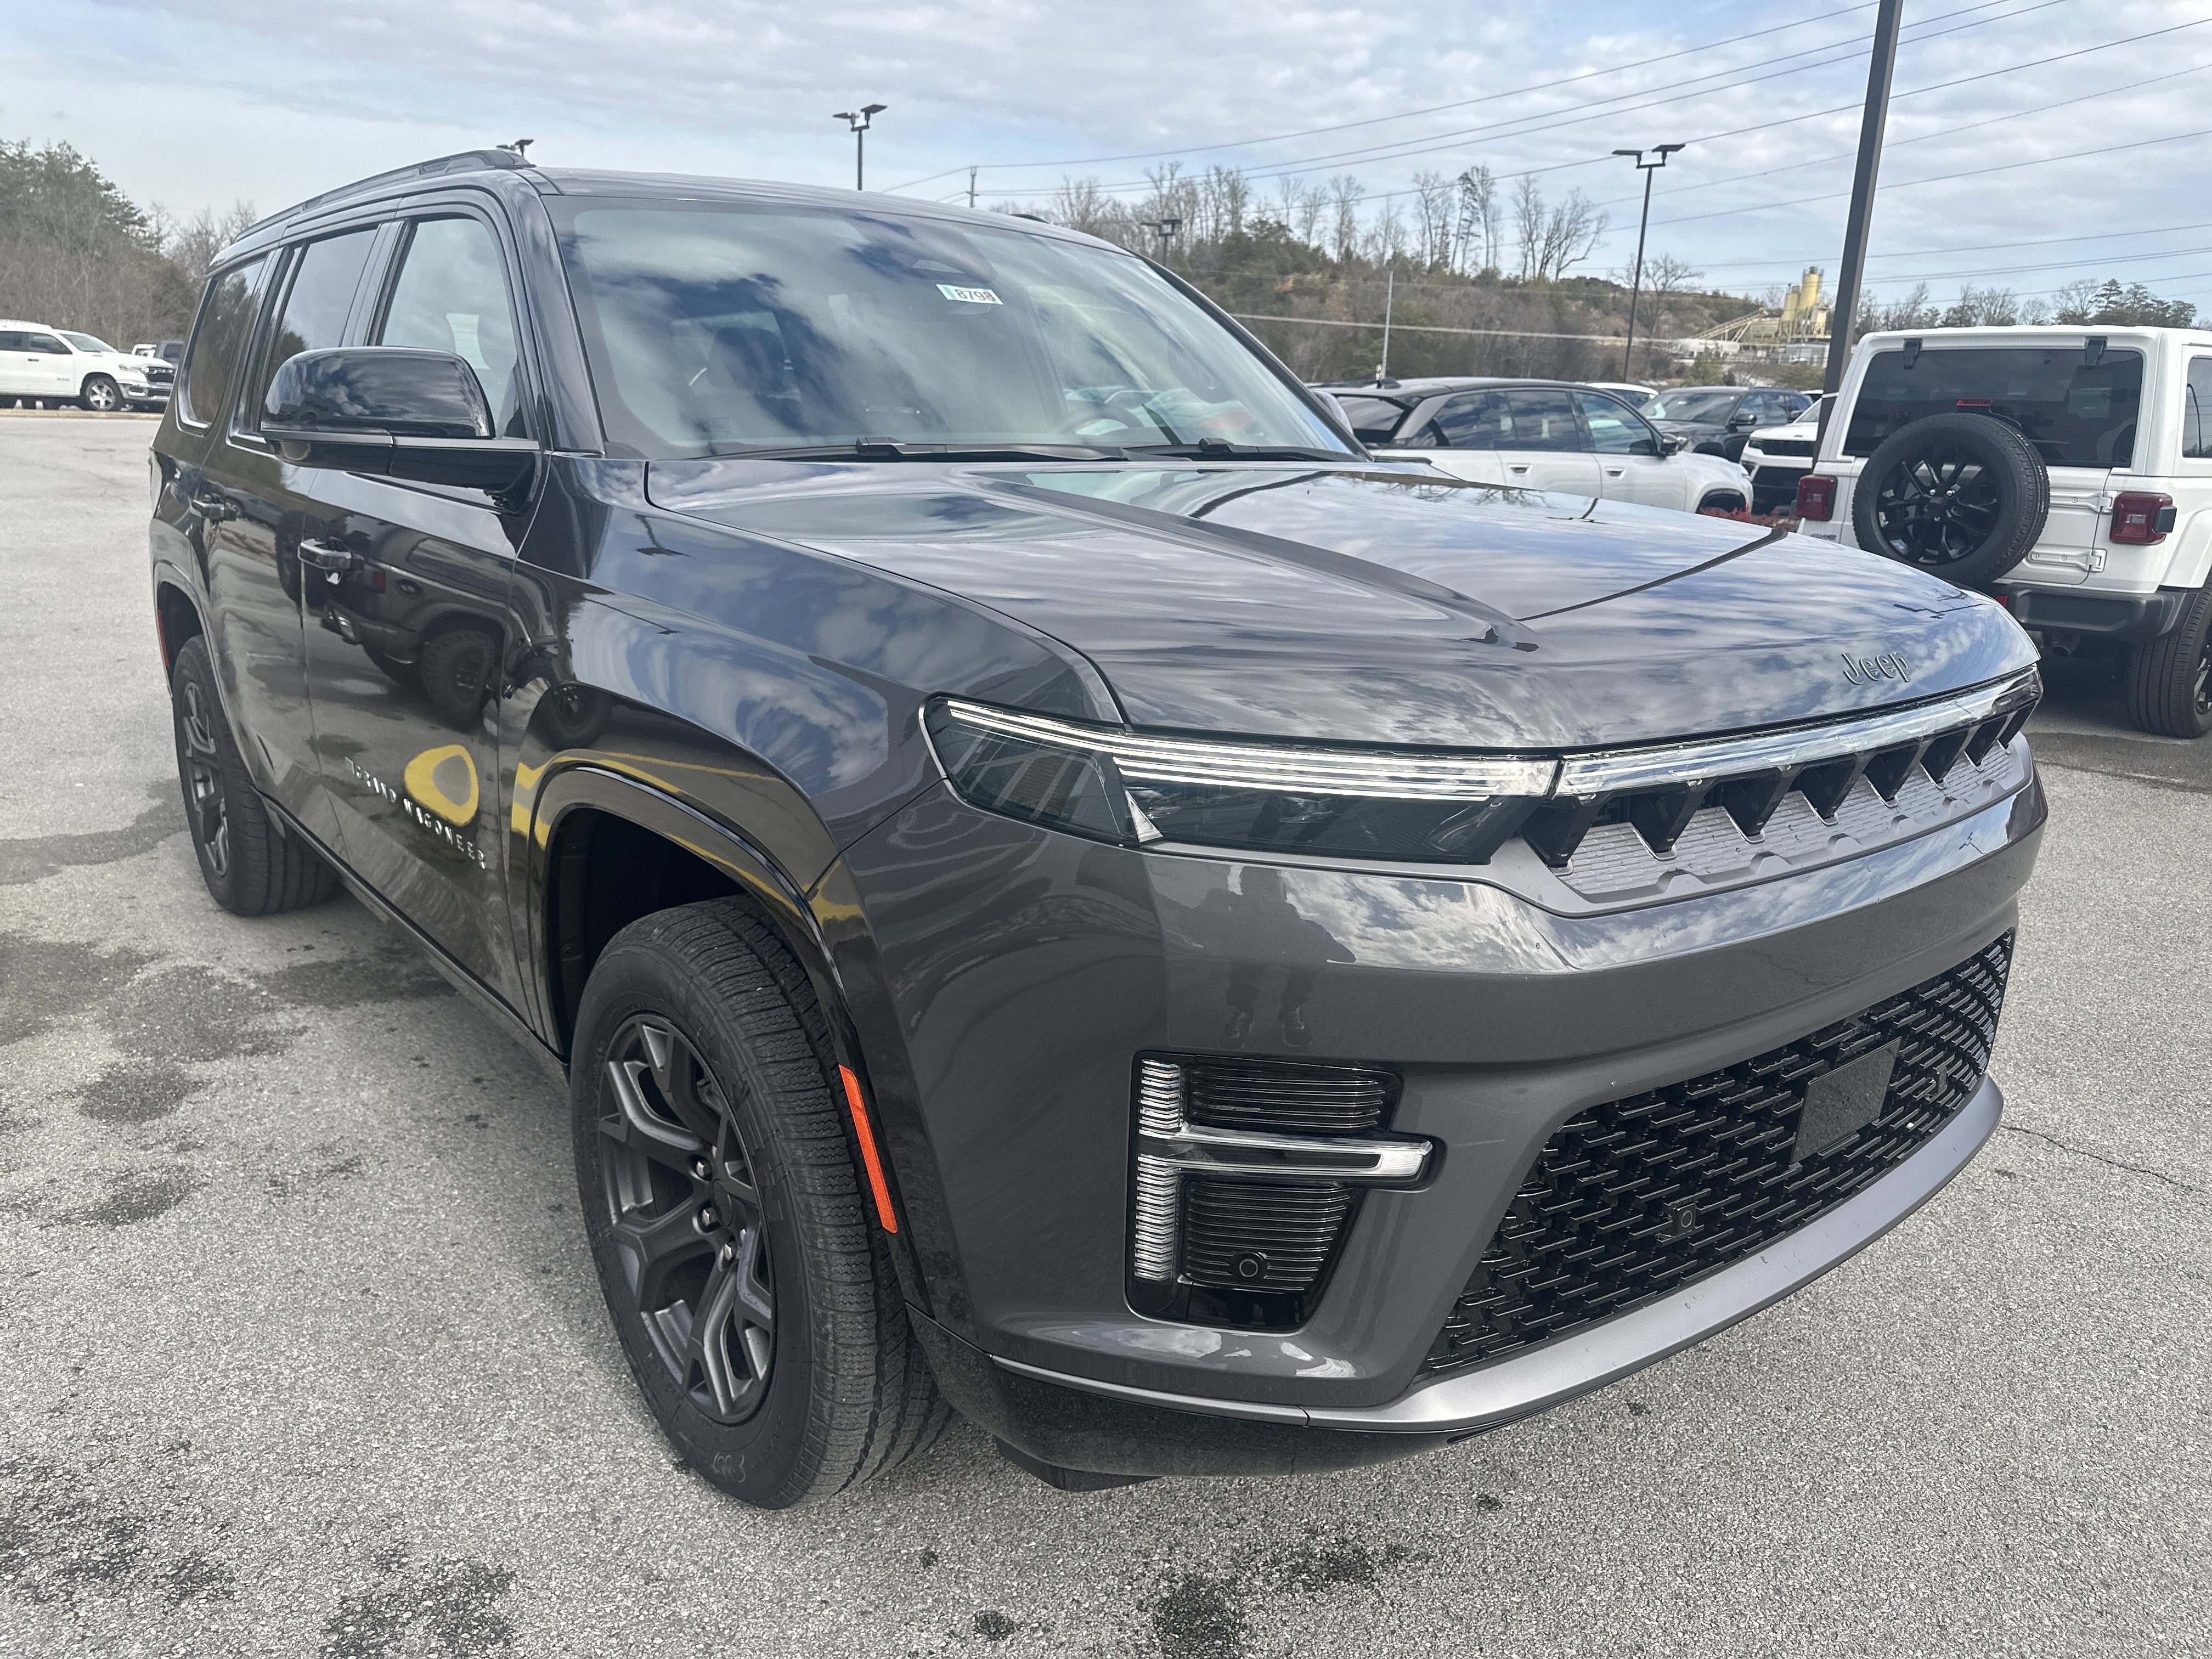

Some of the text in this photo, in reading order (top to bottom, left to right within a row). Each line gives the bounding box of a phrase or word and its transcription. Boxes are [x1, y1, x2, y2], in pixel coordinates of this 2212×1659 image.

[955, 289, 996, 302] 8798
[1841, 652, 1911, 685] Jeep
[403, 798, 487, 870] WAGONEER
